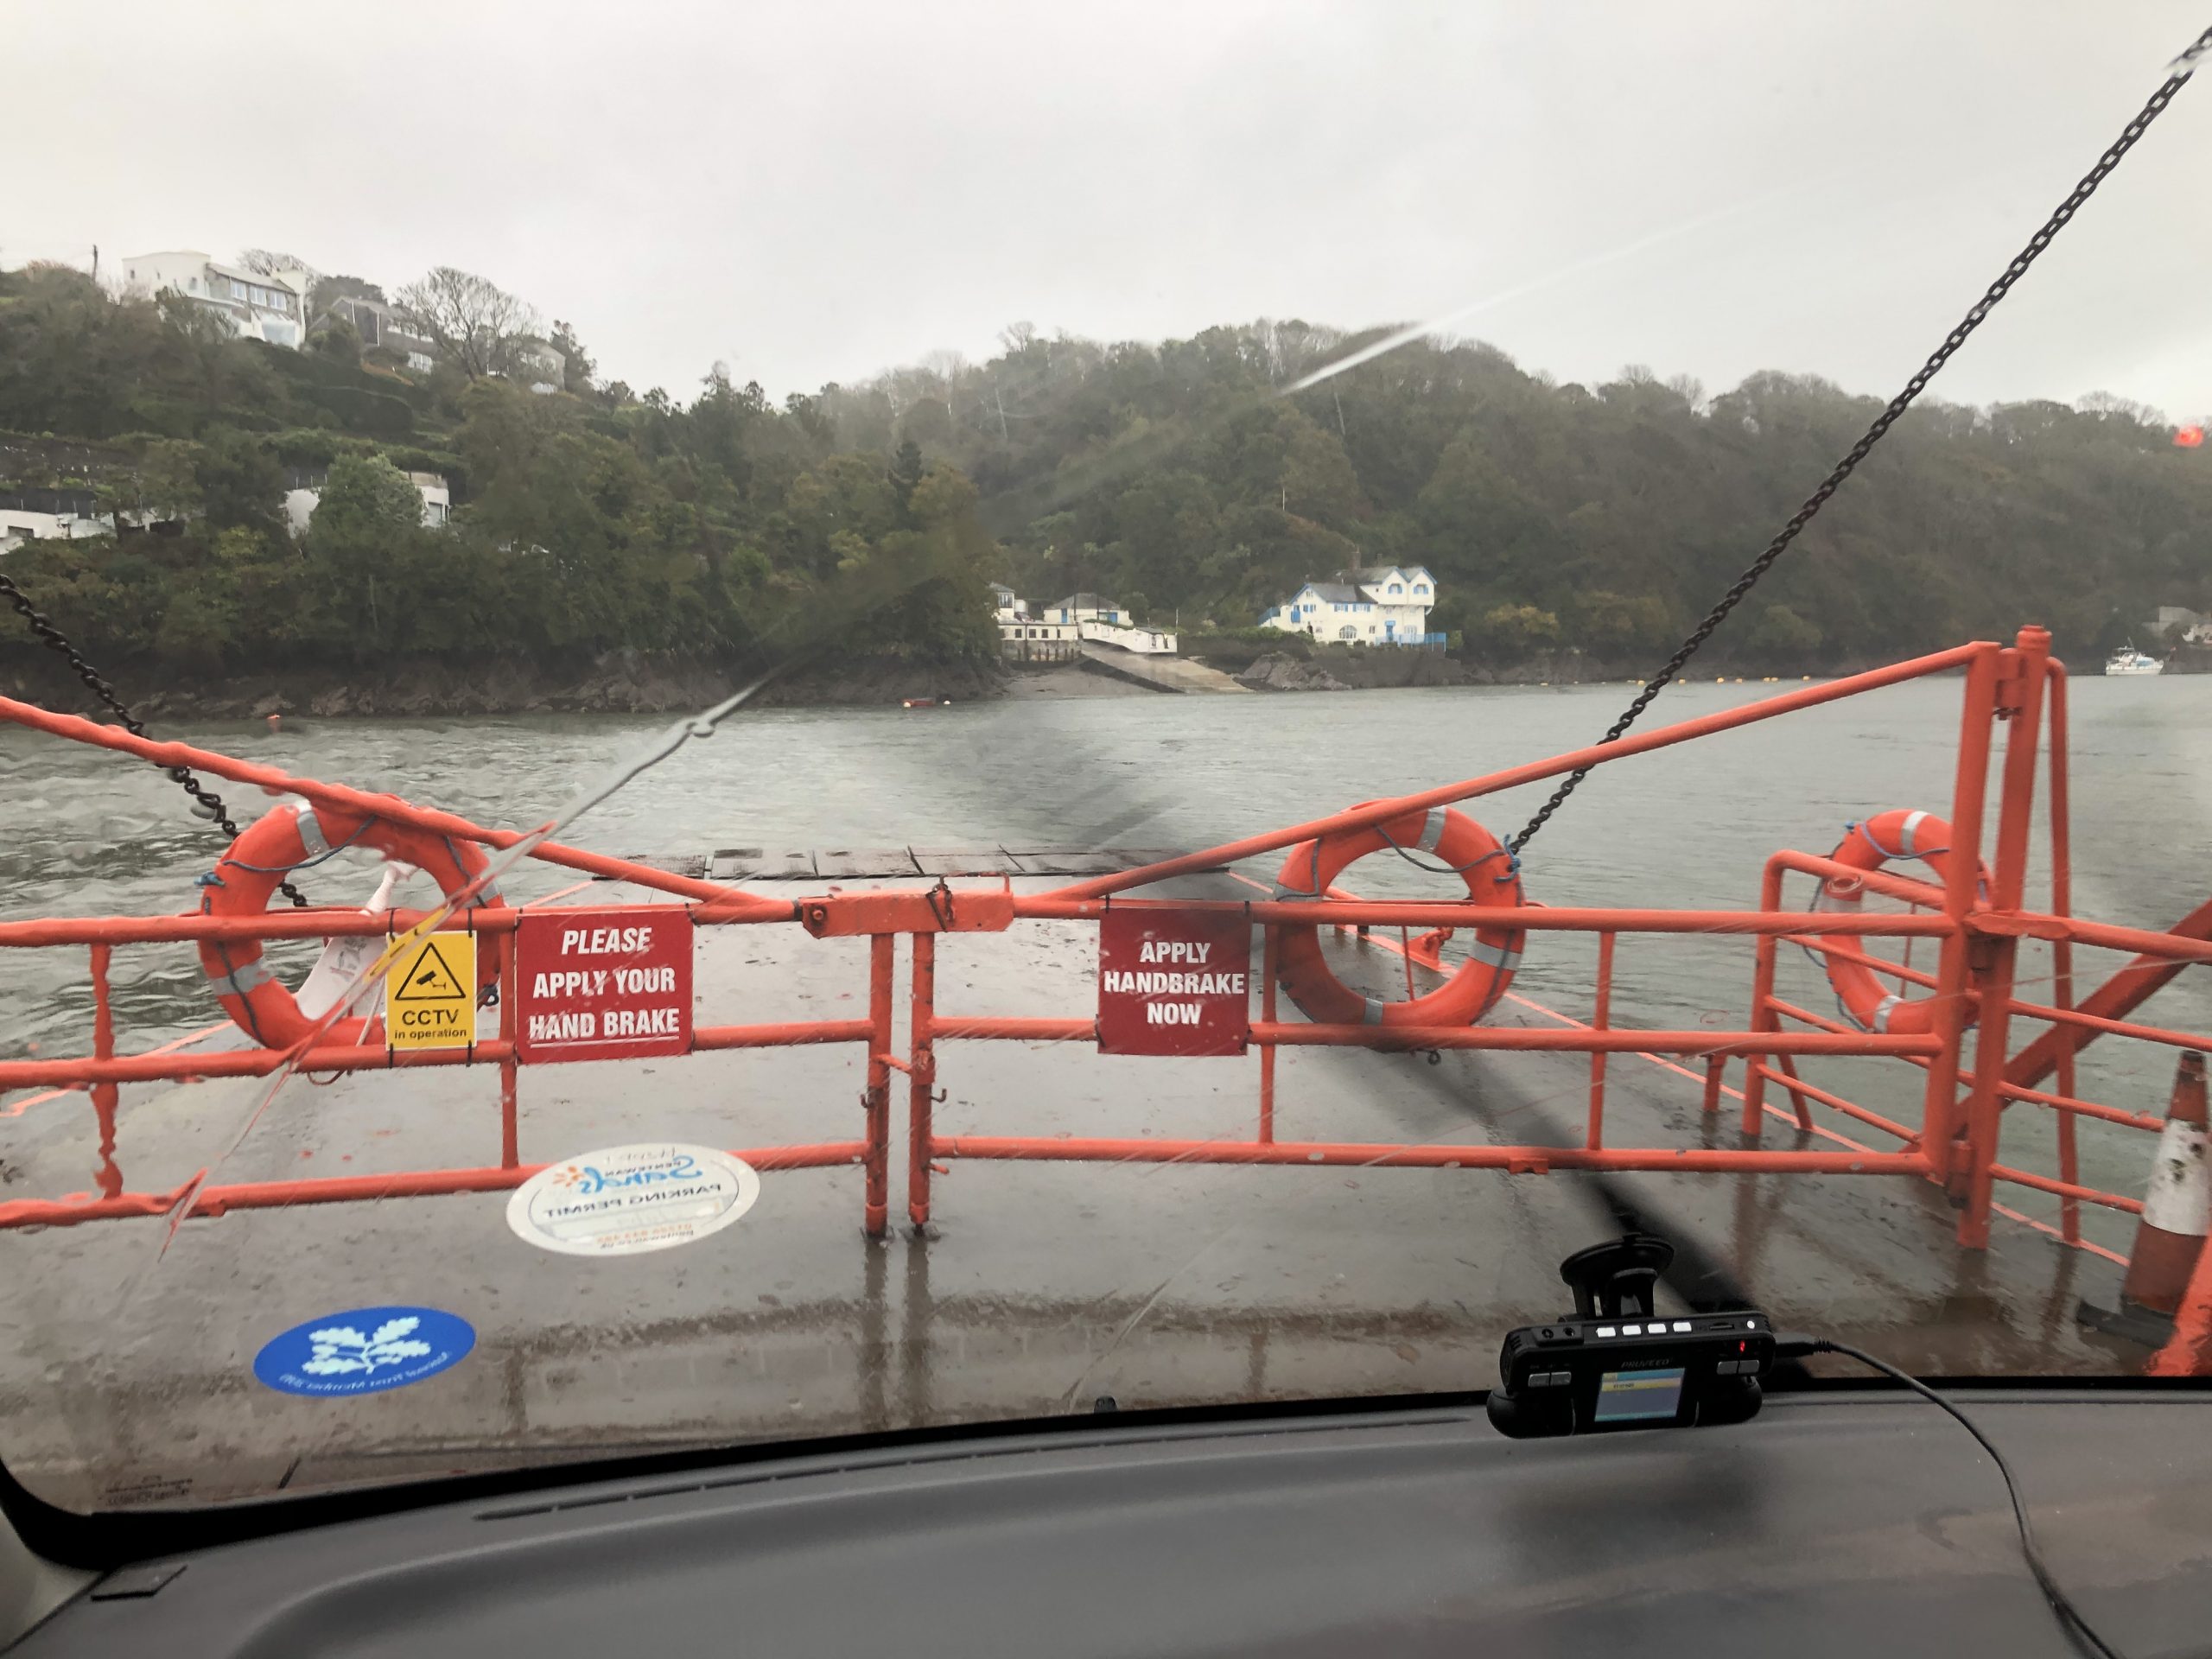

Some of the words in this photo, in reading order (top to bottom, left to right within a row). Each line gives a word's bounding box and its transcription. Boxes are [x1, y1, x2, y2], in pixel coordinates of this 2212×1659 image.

[562, 927, 652, 955] PLEASE
[1139, 941, 1211, 963] APPLY
[533, 969, 607, 999] APPLY
[614, 967, 676, 995] YOUR
[1103, 970, 1244, 995] HANDBRAKE
[402, 1008, 460, 1026] CCTV
[528, 1012, 596, 1039] HAND
[604, 1007, 680, 1036] BRAKE
[1147, 1002, 1202, 1025] NOW
[394, 1029, 406, 1039] in
[410, 1027, 467, 1040] operation
